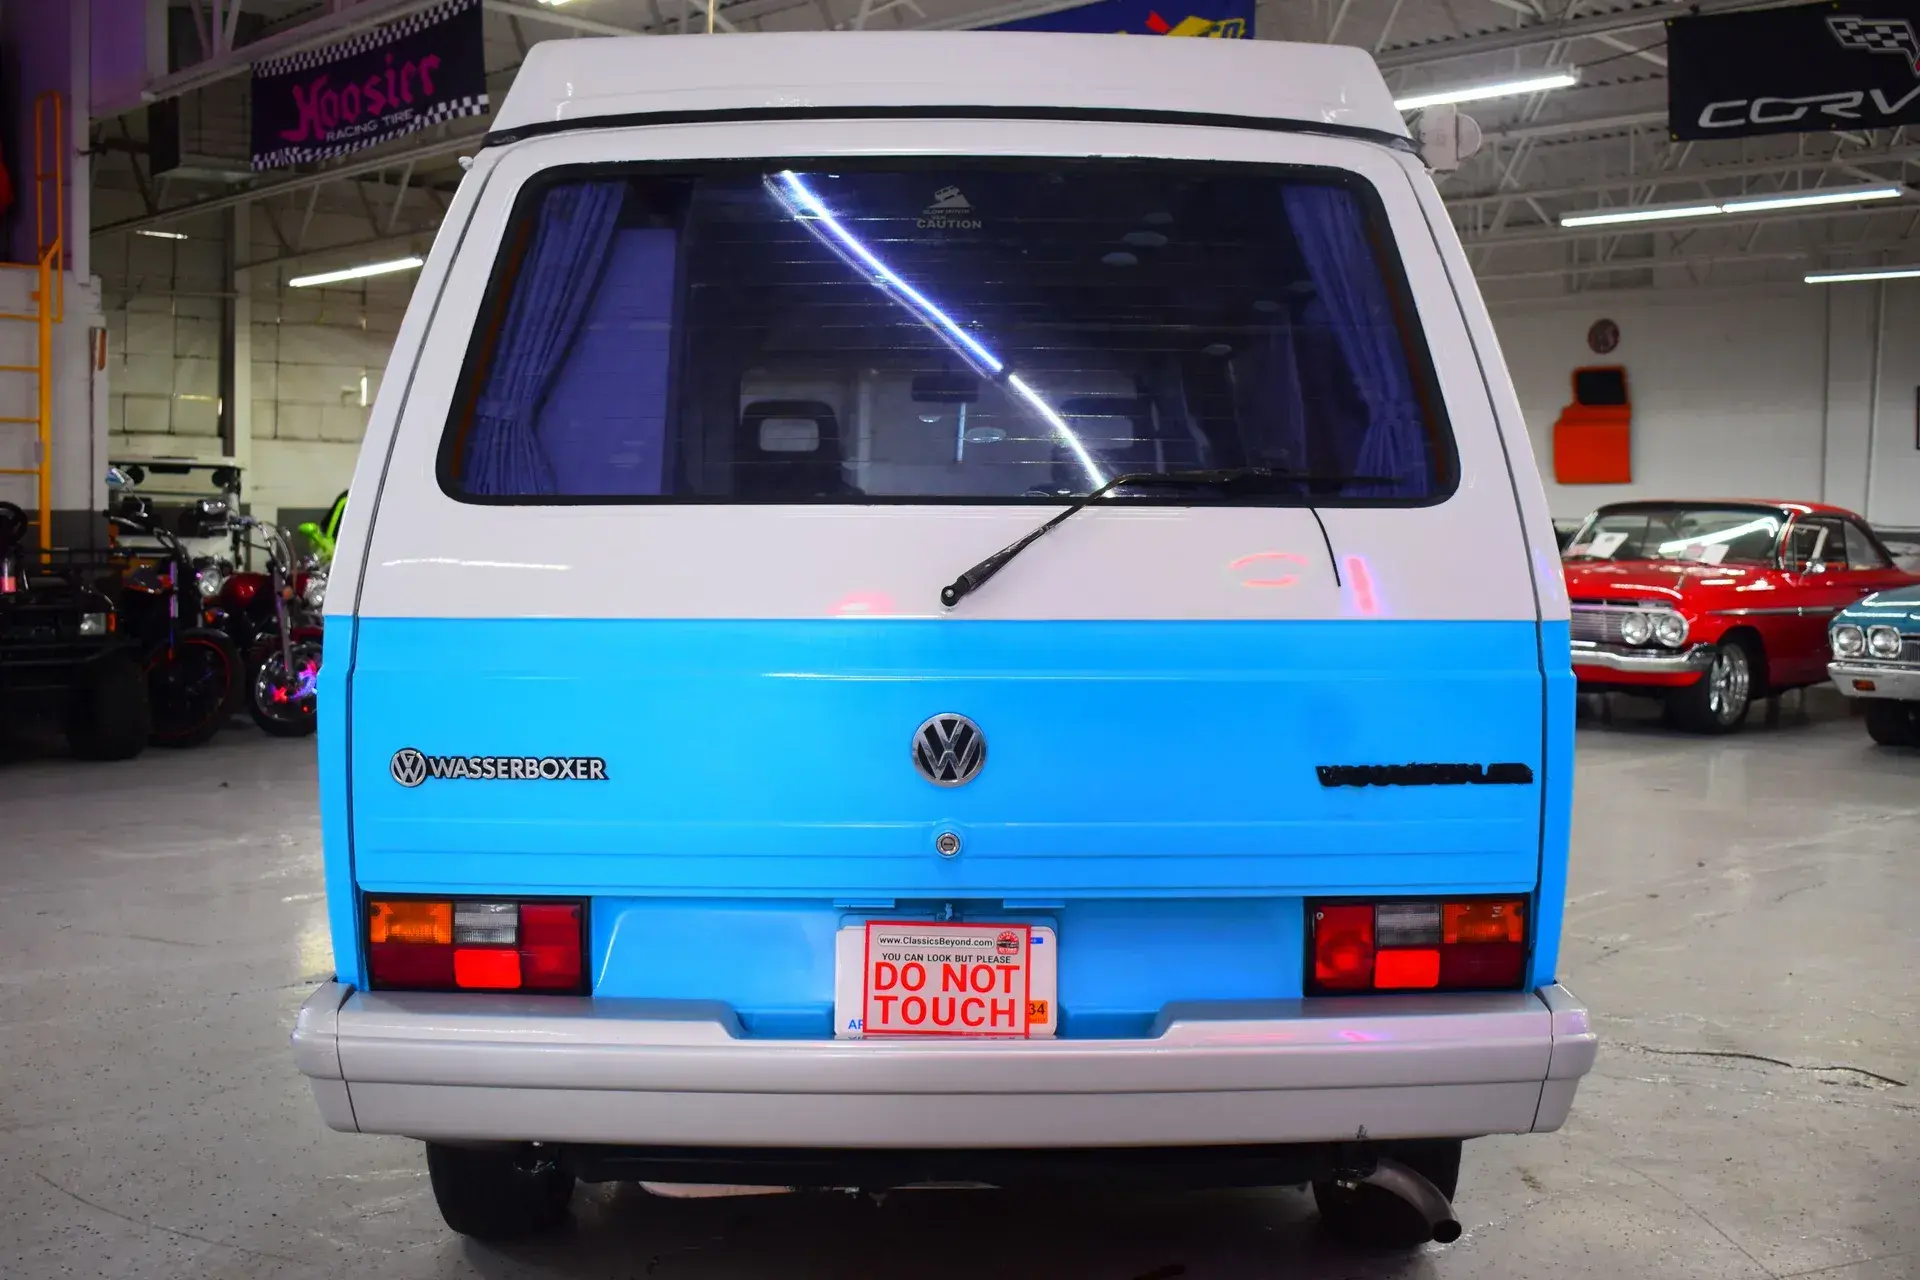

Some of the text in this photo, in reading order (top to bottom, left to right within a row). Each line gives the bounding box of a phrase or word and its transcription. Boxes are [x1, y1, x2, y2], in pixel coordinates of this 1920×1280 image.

[326, 108, 414, 142] RACING TIRE
[916, 220, 982, 229] CAUTION
[429, 757, 607, 779] WASSERBOXER
[879, 936, 992, 947] www.ClassicsBeyond.com
[881, 953, 1011, 964] YOU CAN LOOK BUT PLEASE
[874, 961, 1020, 993] DO NOT
[874, 995, 1016, 1027] TOUCH
